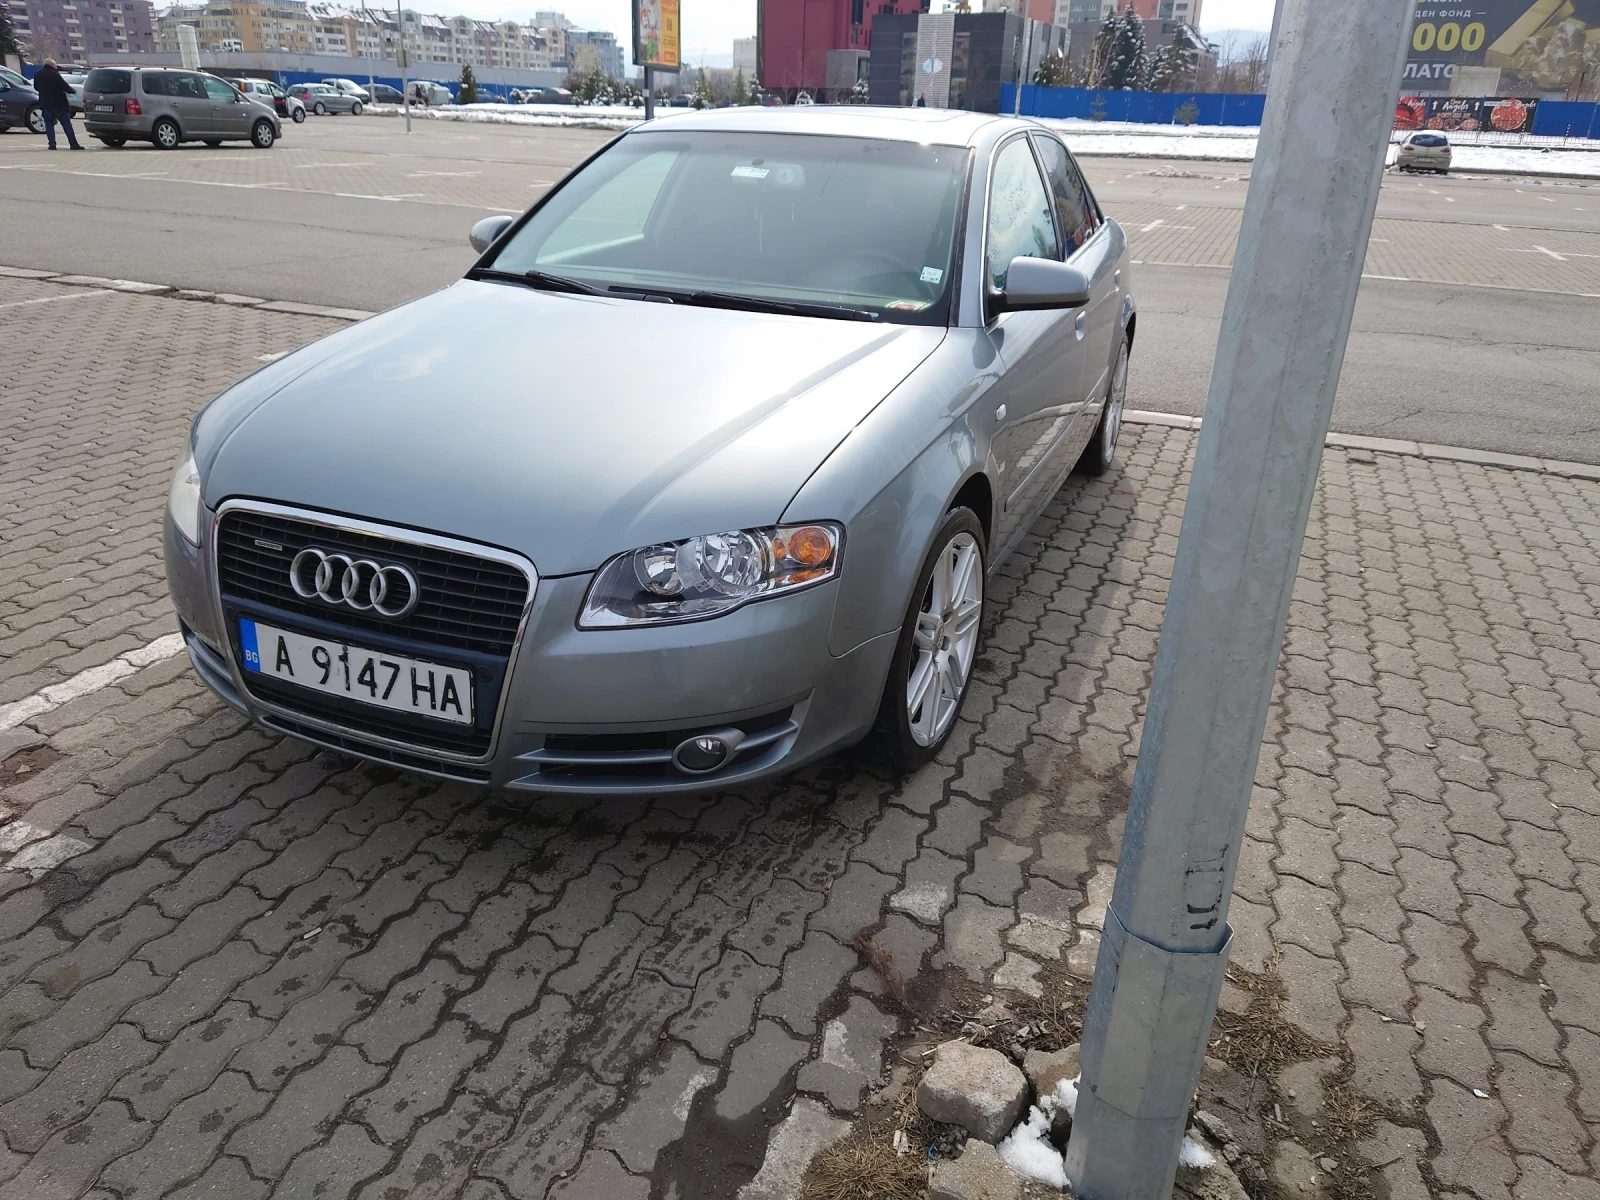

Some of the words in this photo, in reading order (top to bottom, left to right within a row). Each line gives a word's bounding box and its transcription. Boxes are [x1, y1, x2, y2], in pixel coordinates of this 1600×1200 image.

[1440, 9, 1471, 18] ФОНД
[245, 649, 259, 664] BG
[275, 635, 294, 677] A
